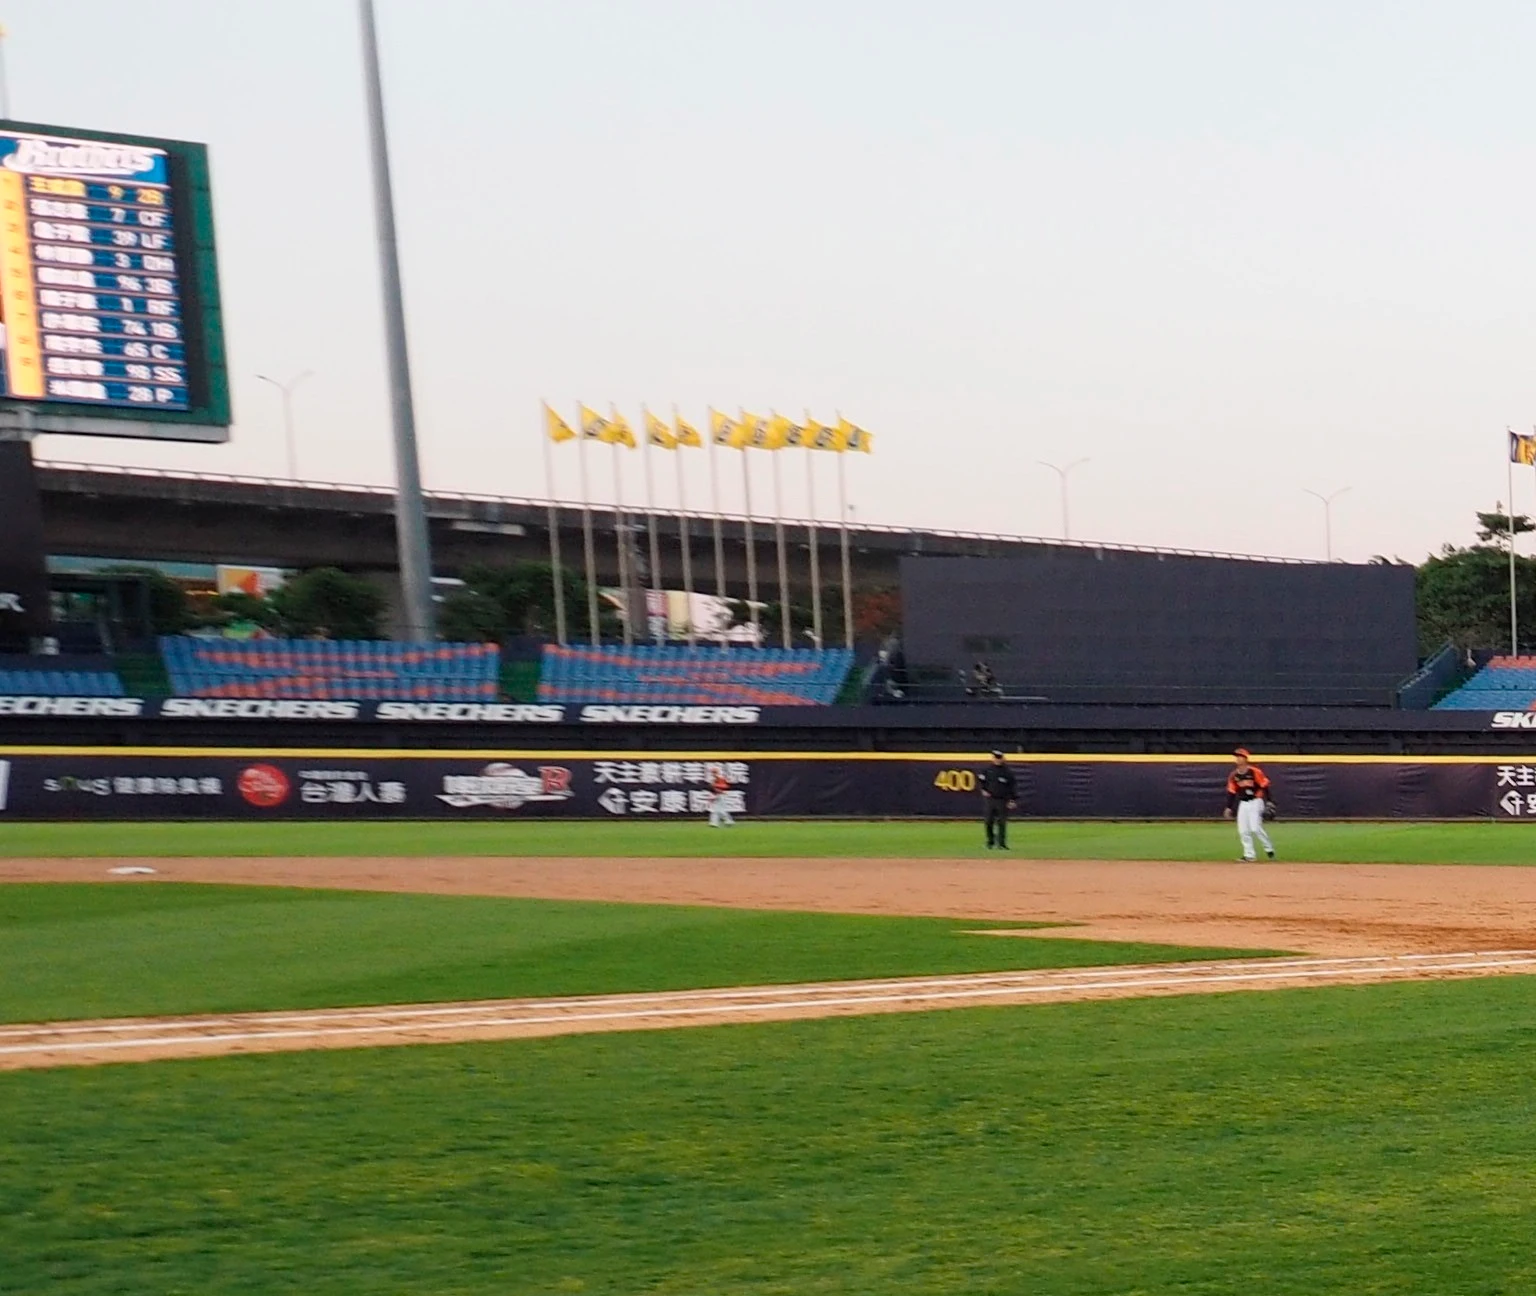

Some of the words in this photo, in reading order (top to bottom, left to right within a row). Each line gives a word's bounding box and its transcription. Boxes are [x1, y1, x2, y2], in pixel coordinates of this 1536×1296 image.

[161, 699, 358, 719] SKECHERS
[376, 702, 564, 721] SKECHERS
[581, 705, 760, 723] SKECHERS
[934, 769, 976, 792] 400
